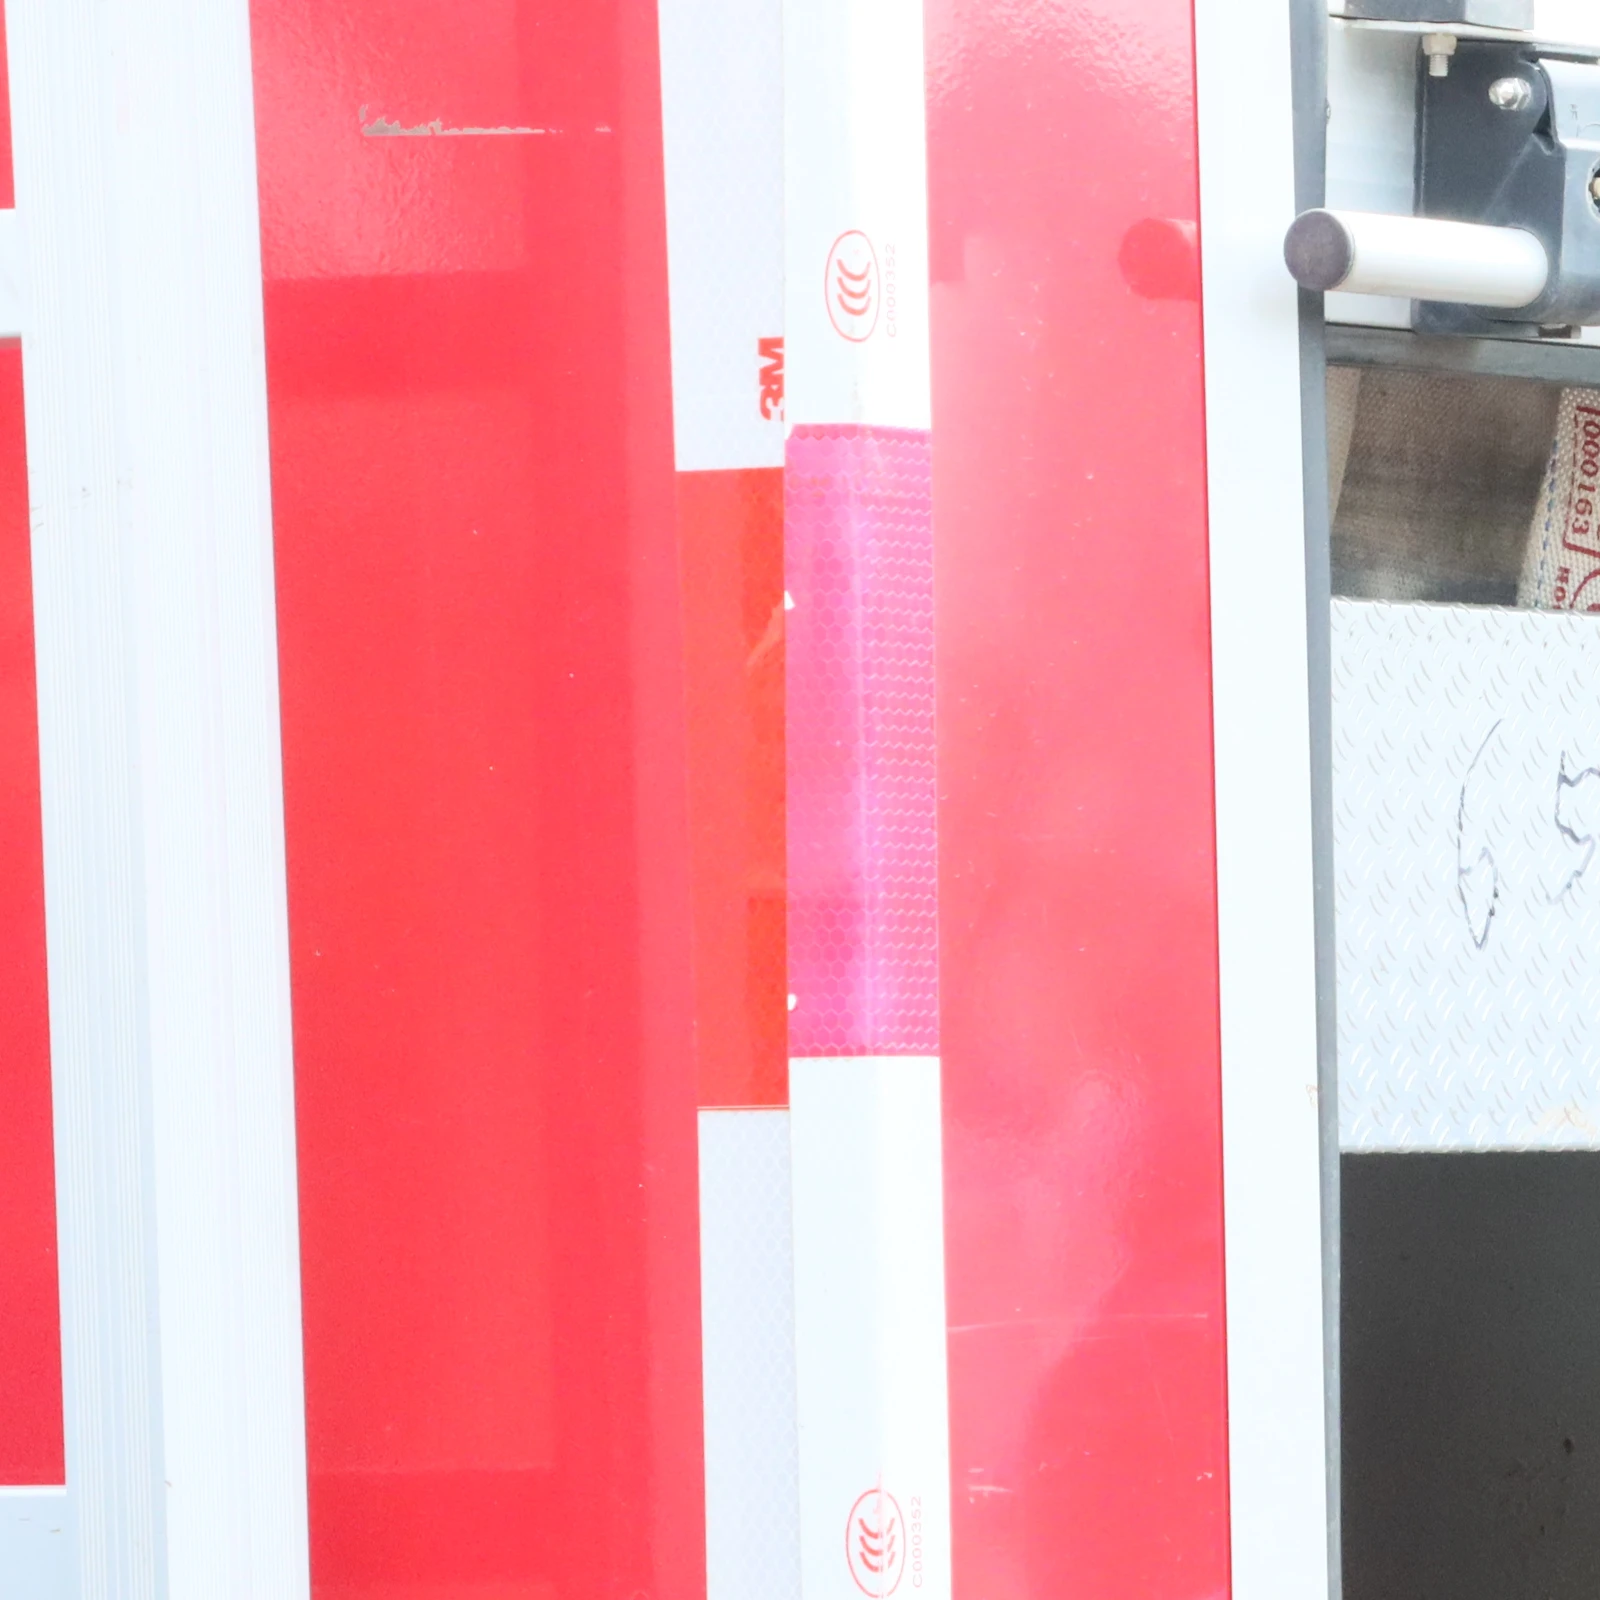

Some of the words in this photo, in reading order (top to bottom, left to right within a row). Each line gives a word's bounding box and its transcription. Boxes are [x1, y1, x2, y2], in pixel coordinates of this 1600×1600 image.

[885, 243, 896, 337] C000352
[756, 336, 785, 423] 3M
[912, 1496, 922, 1588] C000352
